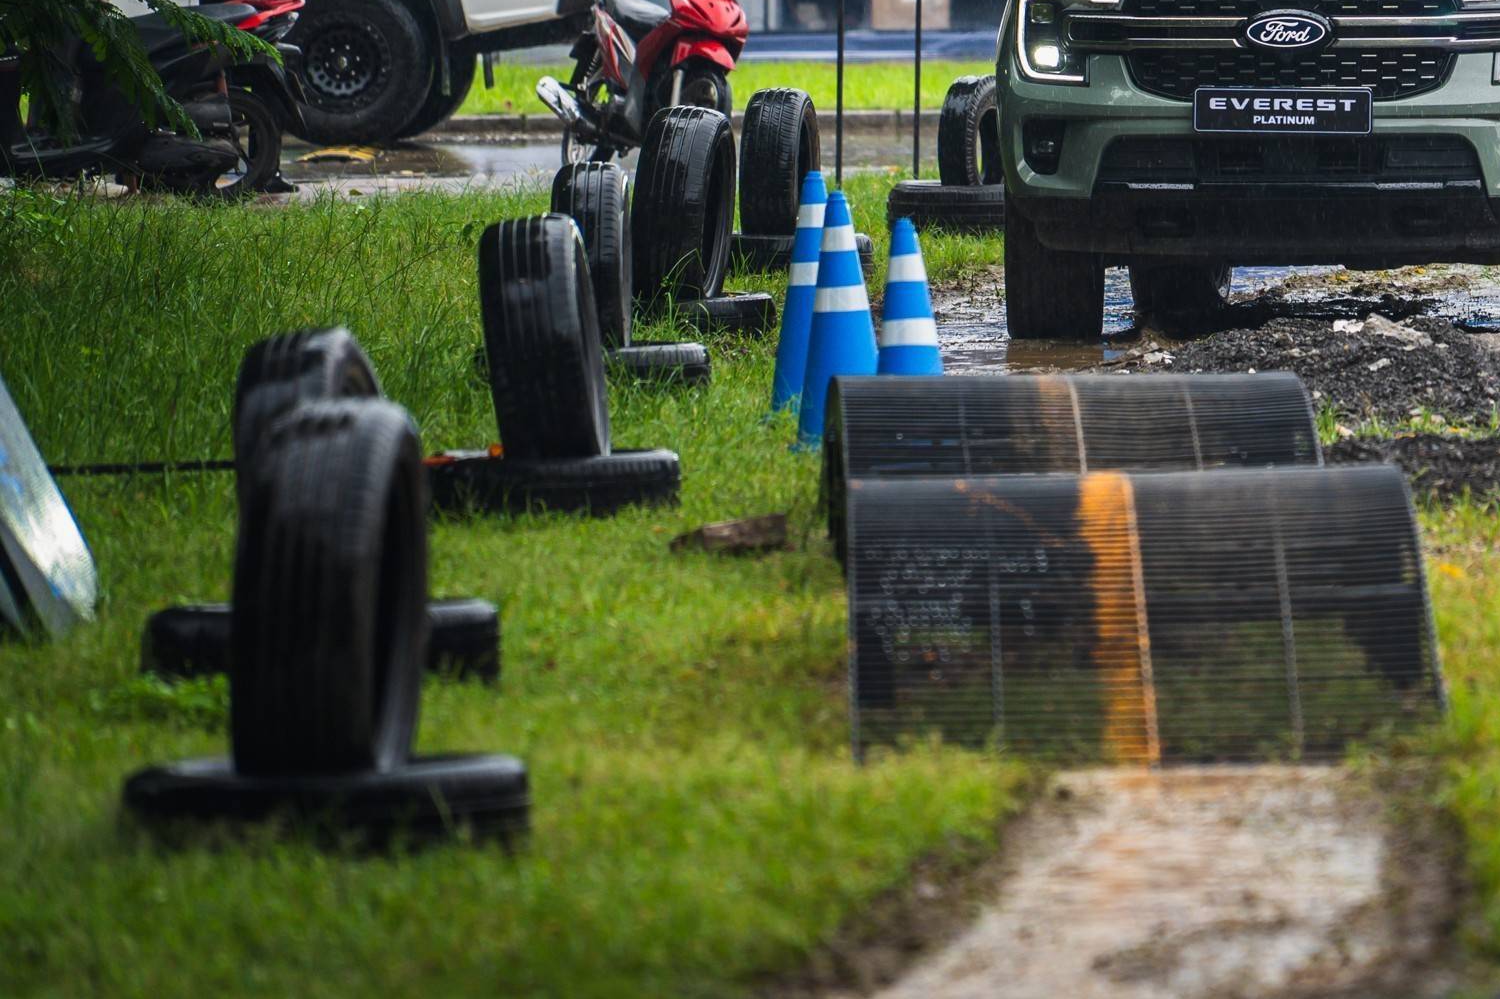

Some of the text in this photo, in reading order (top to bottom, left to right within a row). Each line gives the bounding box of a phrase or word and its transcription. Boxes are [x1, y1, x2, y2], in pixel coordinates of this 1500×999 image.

[1259, 20, 1312, 44] Ford
[1208, 96, 1357, 112] EVEREST
[1252, 114, 1316, 126] PLATINUM
